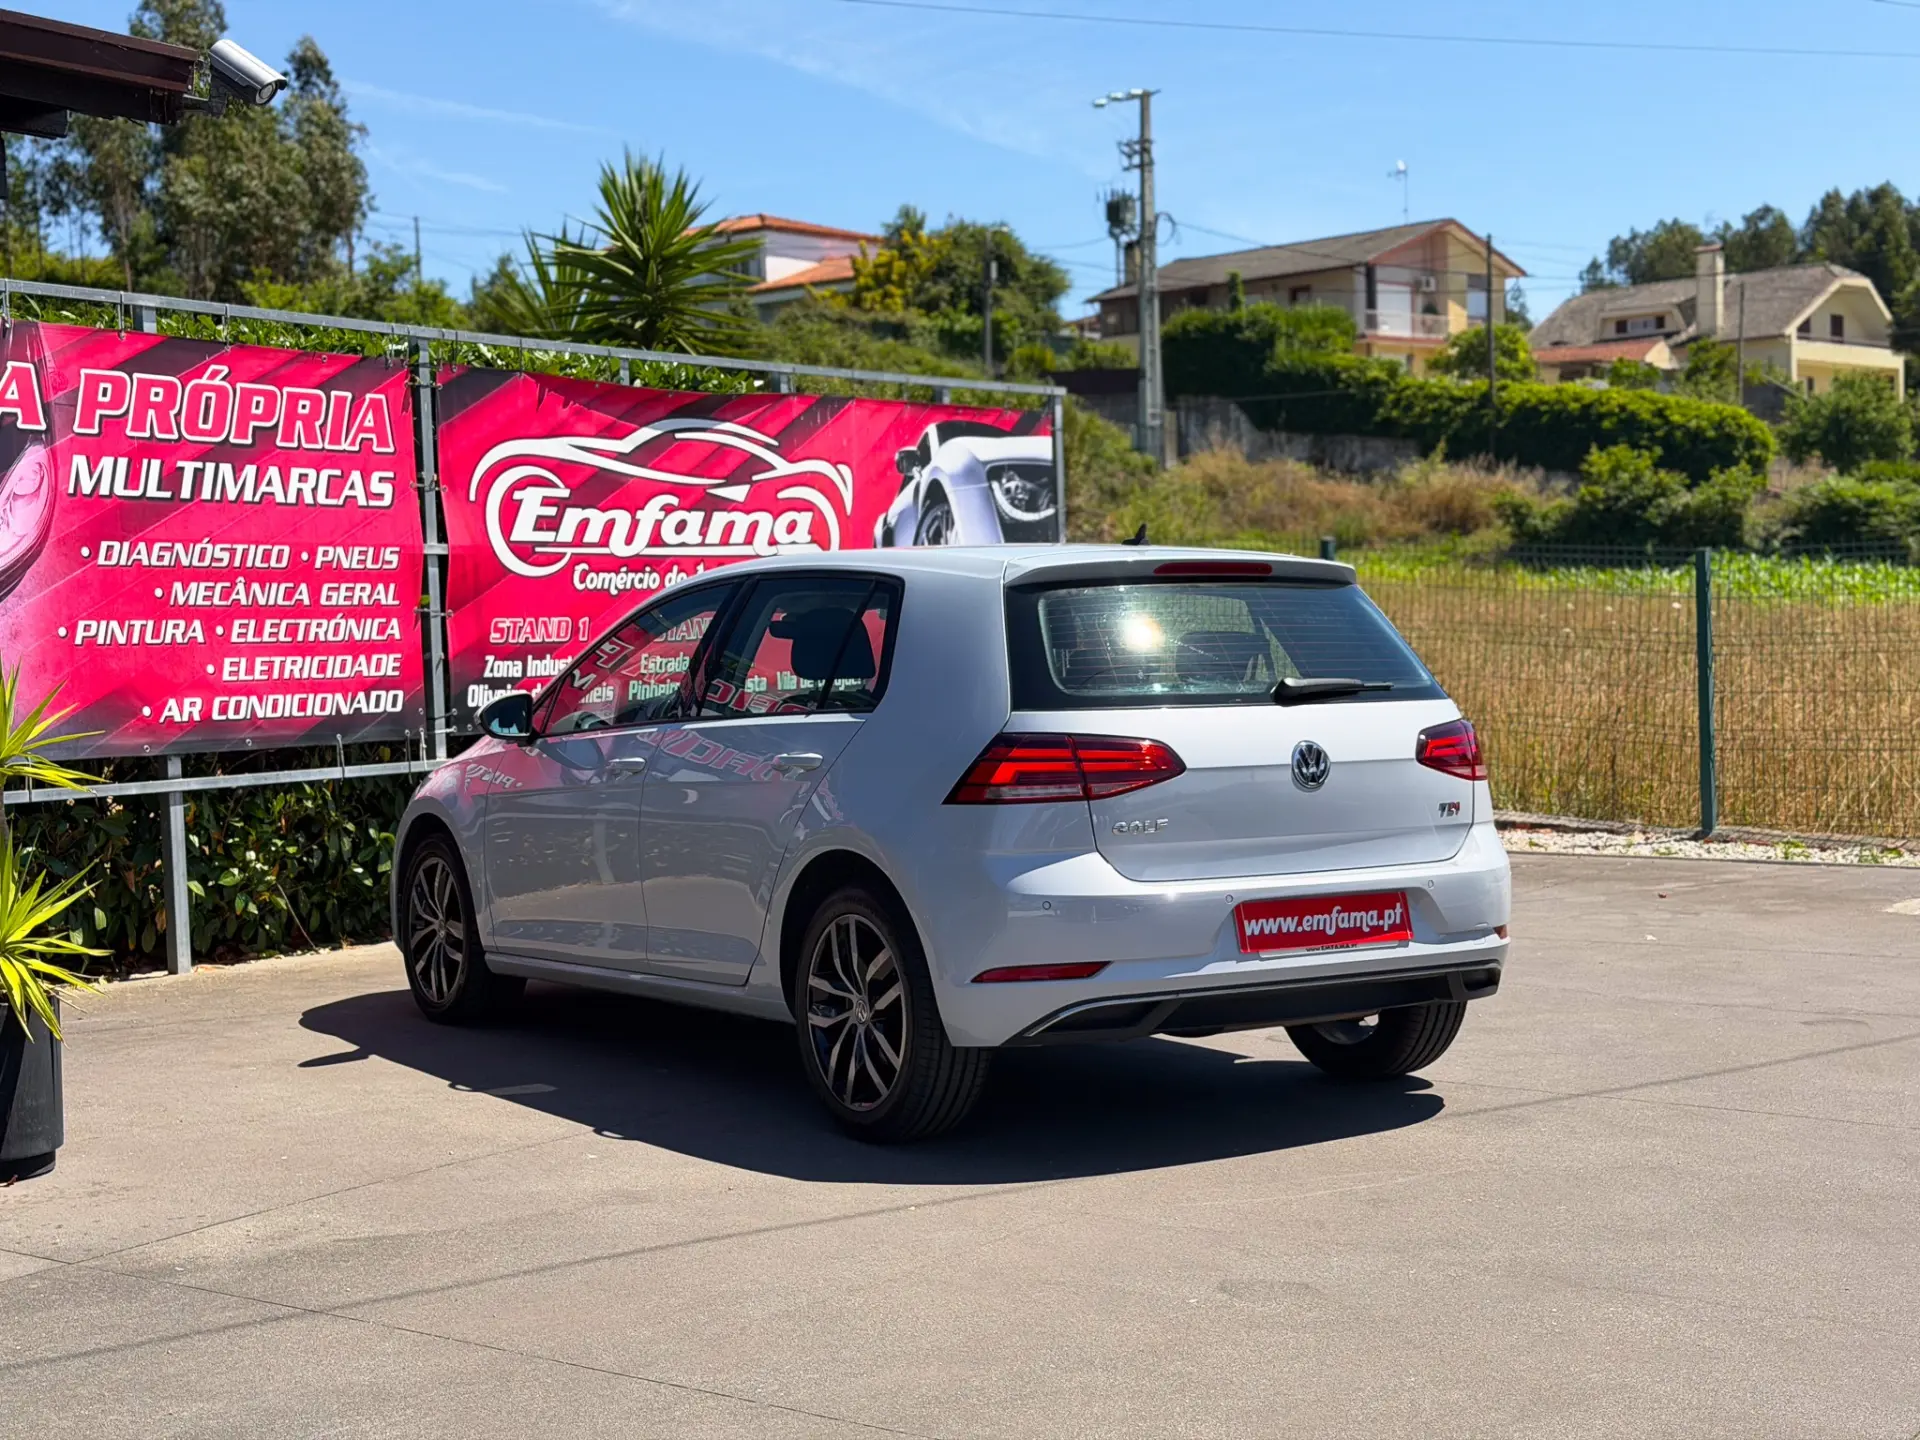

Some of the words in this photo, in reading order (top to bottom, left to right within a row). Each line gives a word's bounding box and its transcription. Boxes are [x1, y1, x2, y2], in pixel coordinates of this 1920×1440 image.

[73, 365, 395, 453] PRÓPRIA
[68, 454, 395, 508] MULTIMARCAS
[509, 485, 814, 557] Emfama
[97, 537, 290, 568] DIAGNÓSTICO
[314, 546, 401, 570] PNEUS
[169, 576, 311, 606] MECÂNICA
[319, 583, 401, 606] GERAL
[573, 562, 660, 595] Comércio
[74, 619, 206, 646] PINTURA
[231, 613, 401, 644] ELECTRÓNICA
[489, 617, 572, 643] STAND
[579, 617, 590, 641] 1
[222, 653, 402, 682] ELETRICIDADE
[483, 655, 522, 678] Zona
[640, 651, 690, 675] Estrada
[159, 697, 203, 724] AR
[211, 690, 404, 721] CONDICIONADO
[1111, 817, 1169, 836] GOLF
[1243, 902, 1403, 936] www.emfama.pt
